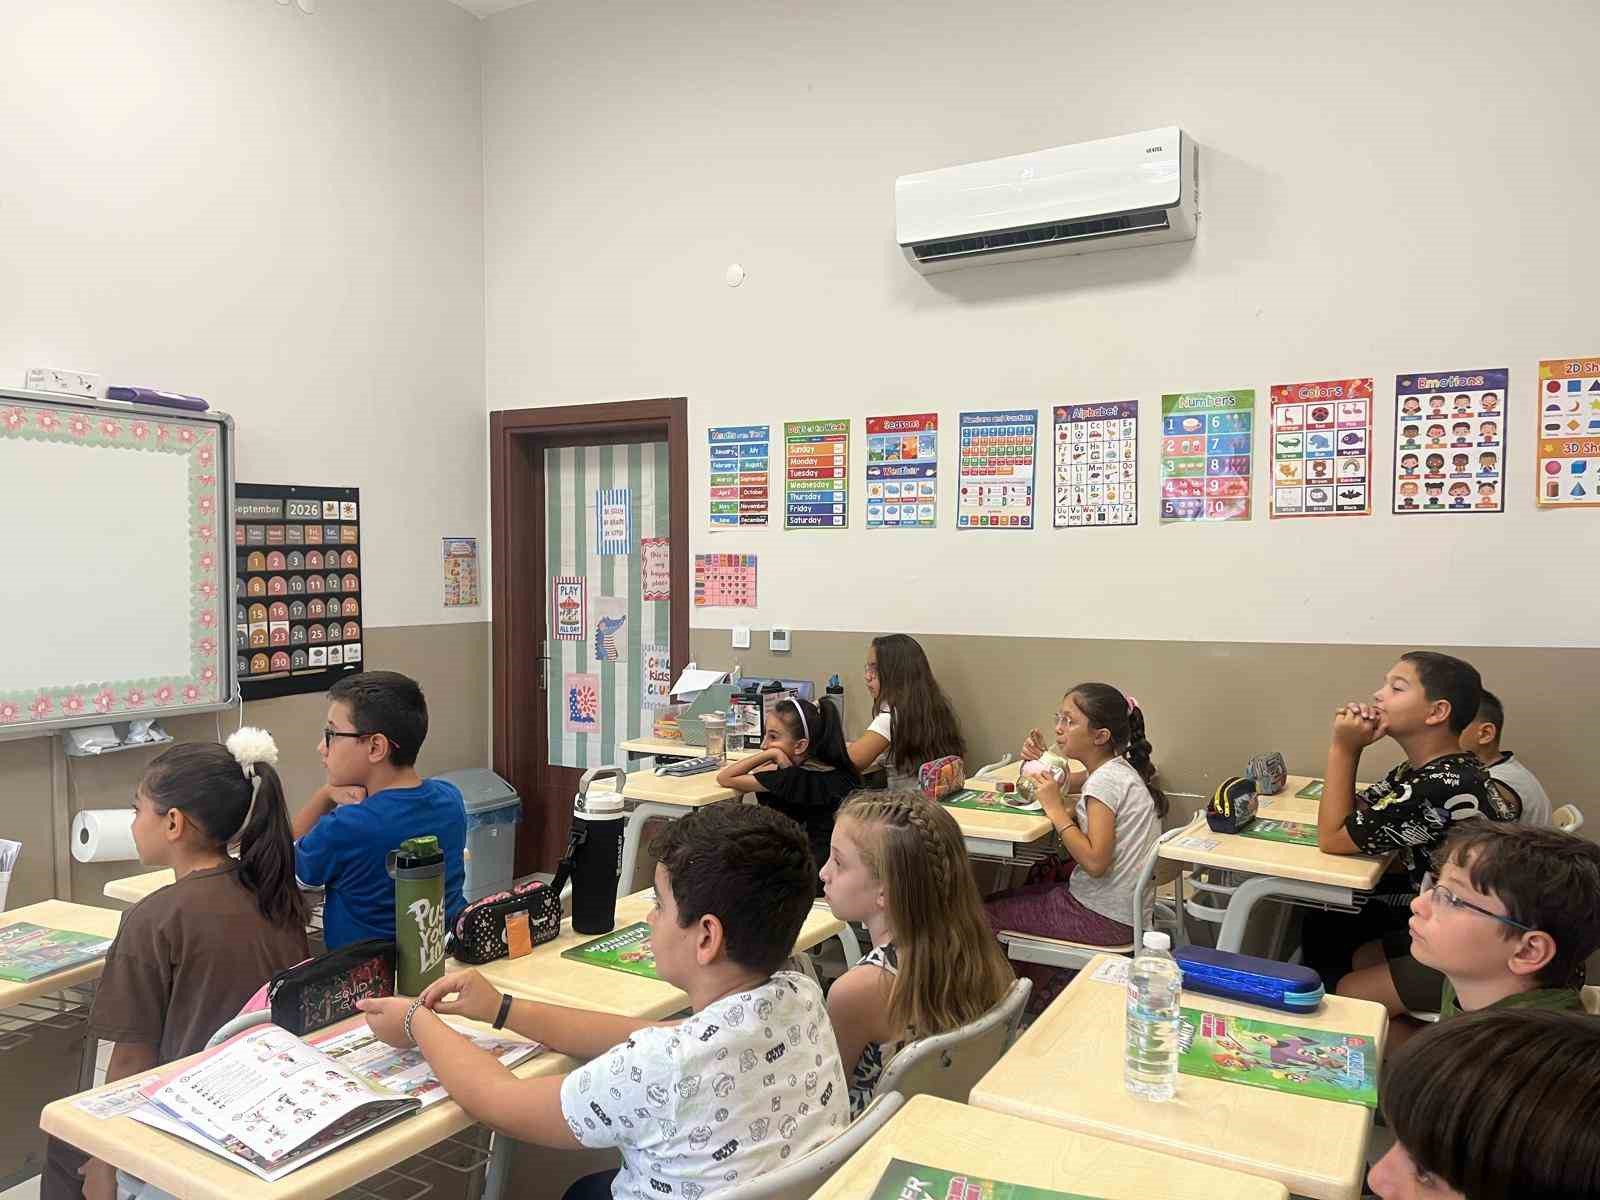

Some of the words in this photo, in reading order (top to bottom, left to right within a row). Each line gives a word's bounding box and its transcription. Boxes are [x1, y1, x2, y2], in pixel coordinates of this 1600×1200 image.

[1565, 363, 1580, 373] 2D
[1584, 363, 1600, 372] Sh
[1417, 375, 1485, 389] Emotions
[1299, 386, 1344, 398] Colors
[1179, 394, 1236, 408] Numbers
[1072, 406, 1118, 420] Alphabet
[883, 420, 920, 430] Seasons
[1168, 418, 1173, 429] 1
[1211, 416, 1219, 428] 6
[1167, 440, 1175, 451] 2
[1211, 439, 1219, 449] 7
[1565, 443, 1578, 453] 3D
[1584, 443, 1600, 452] Sh
[790, 446, 815, 454] Sunday
[790, 458, 818, 466] Monday
[1167, 461, 1174, 471] 3
[1211, 459, 1219, 470] 8
[790, 469, 818, 478] Tuesday
[790, 481, 829, 490] Wednesday
[1166, 482, 1174, 492] 4
[1210, 480, 1218, 491] 9
[790, 493, 821, 501] Thursday
[290, 504, 319, 516] 2026
[790, 505, 812, 513] Friday
[1165, 502, 1173, 512] 5
[1208, 501, 1223, 512] 10
[790, 516, 821, 525] Saturday
[273, 558, 279, 566] 2
[293, 557, 298, 565] 3
[311, 556, 316, 564] 4
[329, 556, 335, 564] 5
[347, 555, 352, 563] 6
[254, 583, 259, 591] 8
[274, 583, 280, 591] 9
[292, 583, 301, 591] 10
[310, 581, 320, 589] 11
[329, 580, 337, 588] 12
[346, 580, 355, 588] 13
[560, 585, 578, 596] PLAY
[252, 610, 263, 619] 15
[273, 607, 283, 616] 16
[292, 607, 302, 615] 17
[311, 605, 321, 613] 18
[329, 604, 338, 612] 19
[346, 604, 356, 612] 20
[254, 635, 264, 644] 22
[274, 633, 285, 641] 23
[294, 631, 303, 640] 24
[311, 630, 322, 639] 25
[330, 628, 339, 637] 26
[347, 627, 357, 636] 27
[254, 660, 265, 669] 29
[275, 657, 286, 666] 30
[649, 670, 670, 681] kids
[648, 683, 670, 696] CLU
[332, 981, 368, 1003] SQUID
